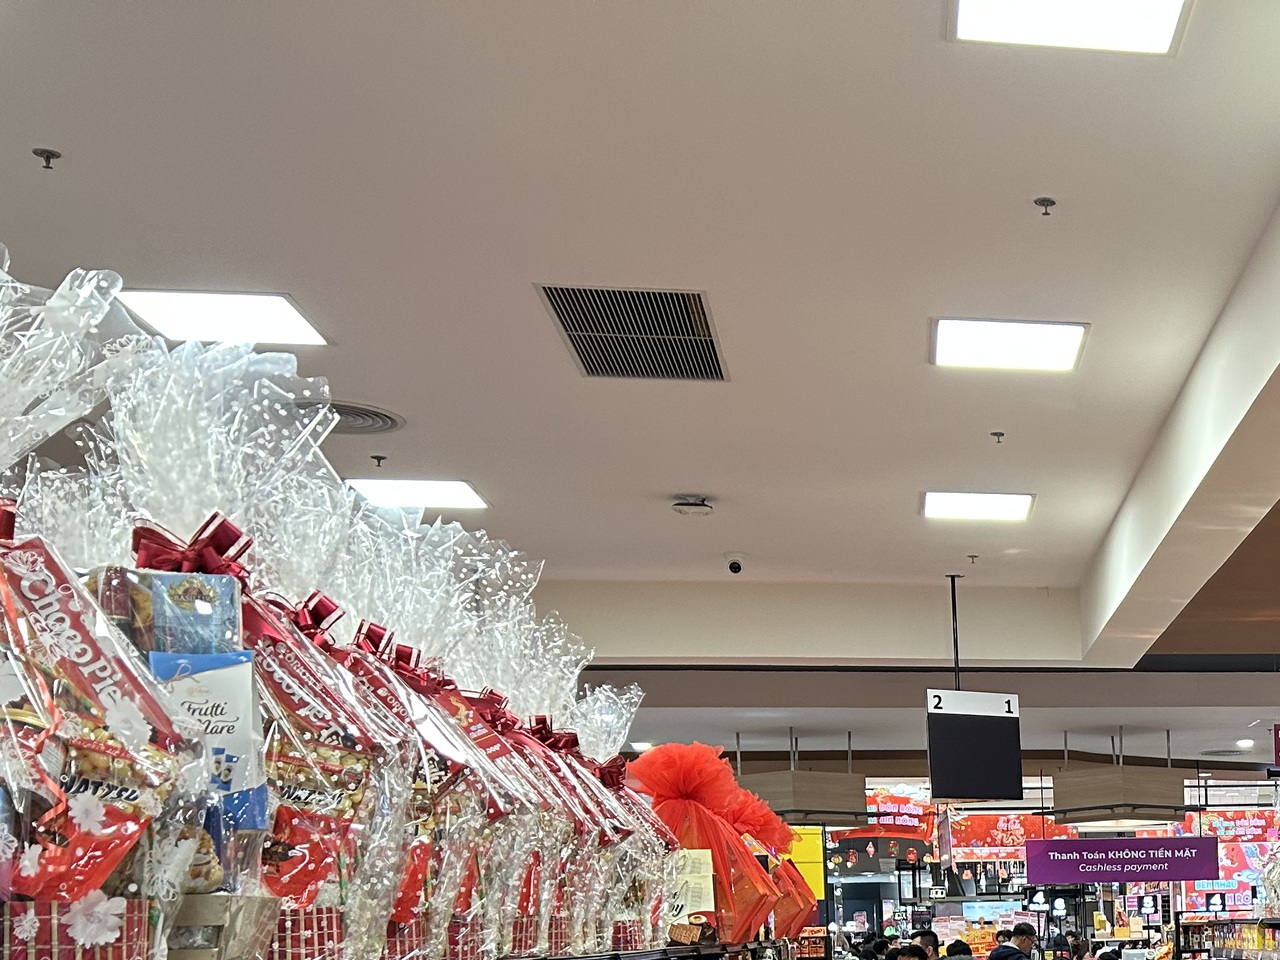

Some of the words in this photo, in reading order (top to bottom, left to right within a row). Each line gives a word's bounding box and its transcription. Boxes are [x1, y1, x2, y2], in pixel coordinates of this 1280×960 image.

[181, 700, 228, 717] Frutti
[932, 695, 943, 709] 2
[1004, 699, 1013, 714] 1
[1048, 851, 1080, 861] Thanh
[1083, 850, 1106, 860] Toán
[1108, 848, 1146, 860] KHÔNG
[1149, 847, 1172, 859] TIỀN
[1175, 847, 1198, 860] MẶT
[1079, 862, 1122, 873] Cashless
[1124, 862, 1169, 873] payment
